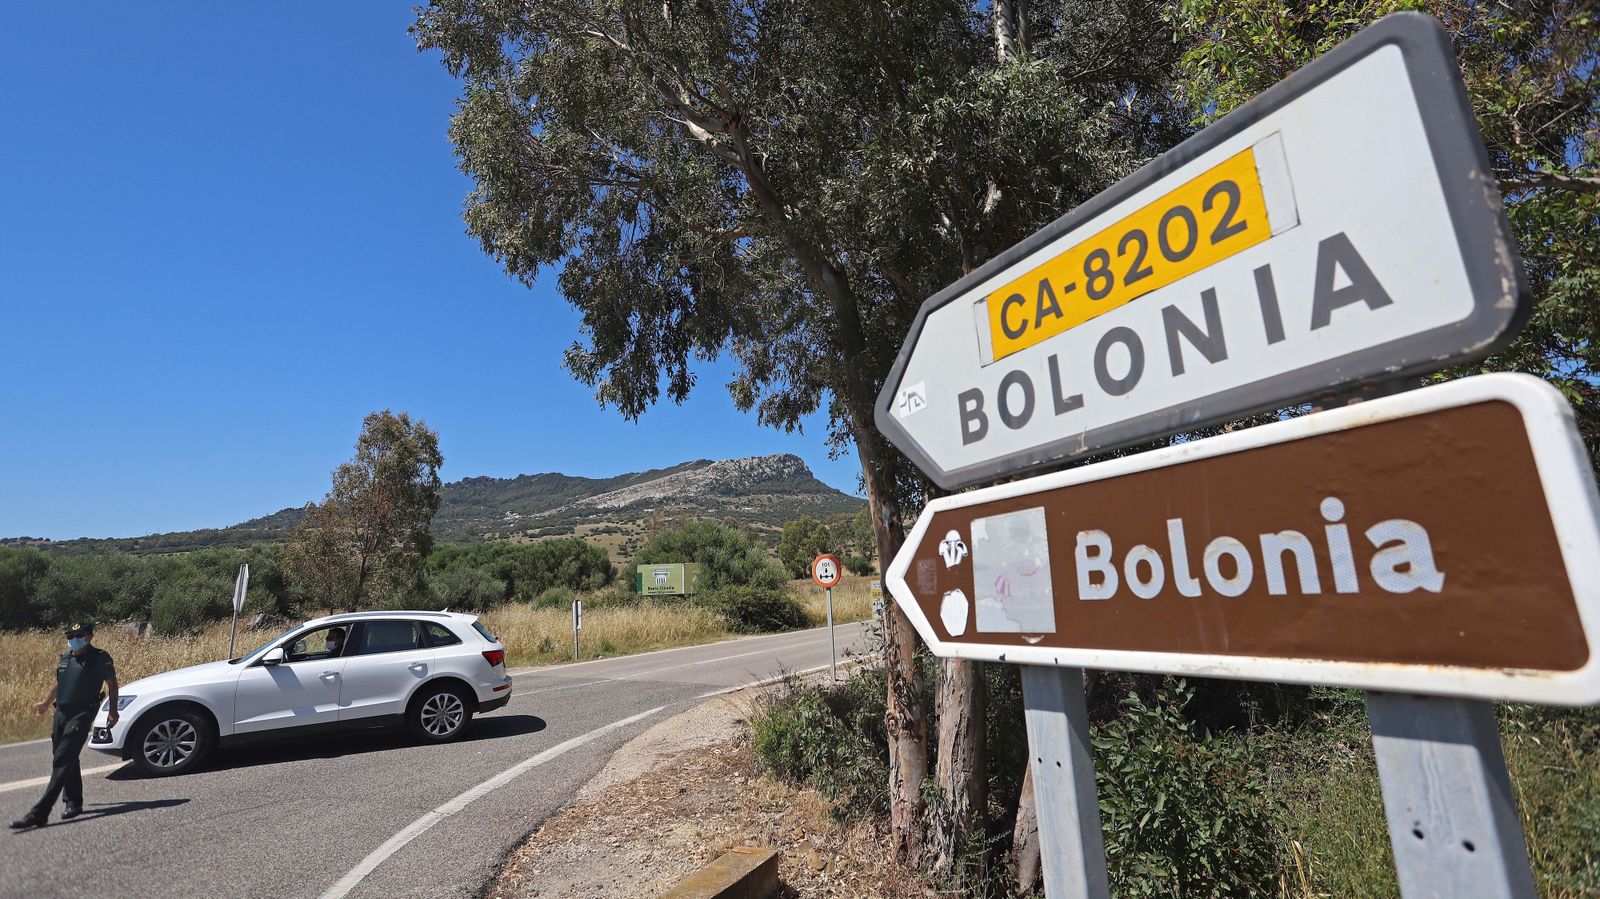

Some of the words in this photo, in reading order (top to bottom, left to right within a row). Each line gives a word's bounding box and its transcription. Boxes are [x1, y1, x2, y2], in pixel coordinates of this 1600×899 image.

[957, 231, 1394, 447] BOLONIA
[1000, 179, 1248, 340] CA-8202
[1075, 496, 1445, 601] Bolonia
